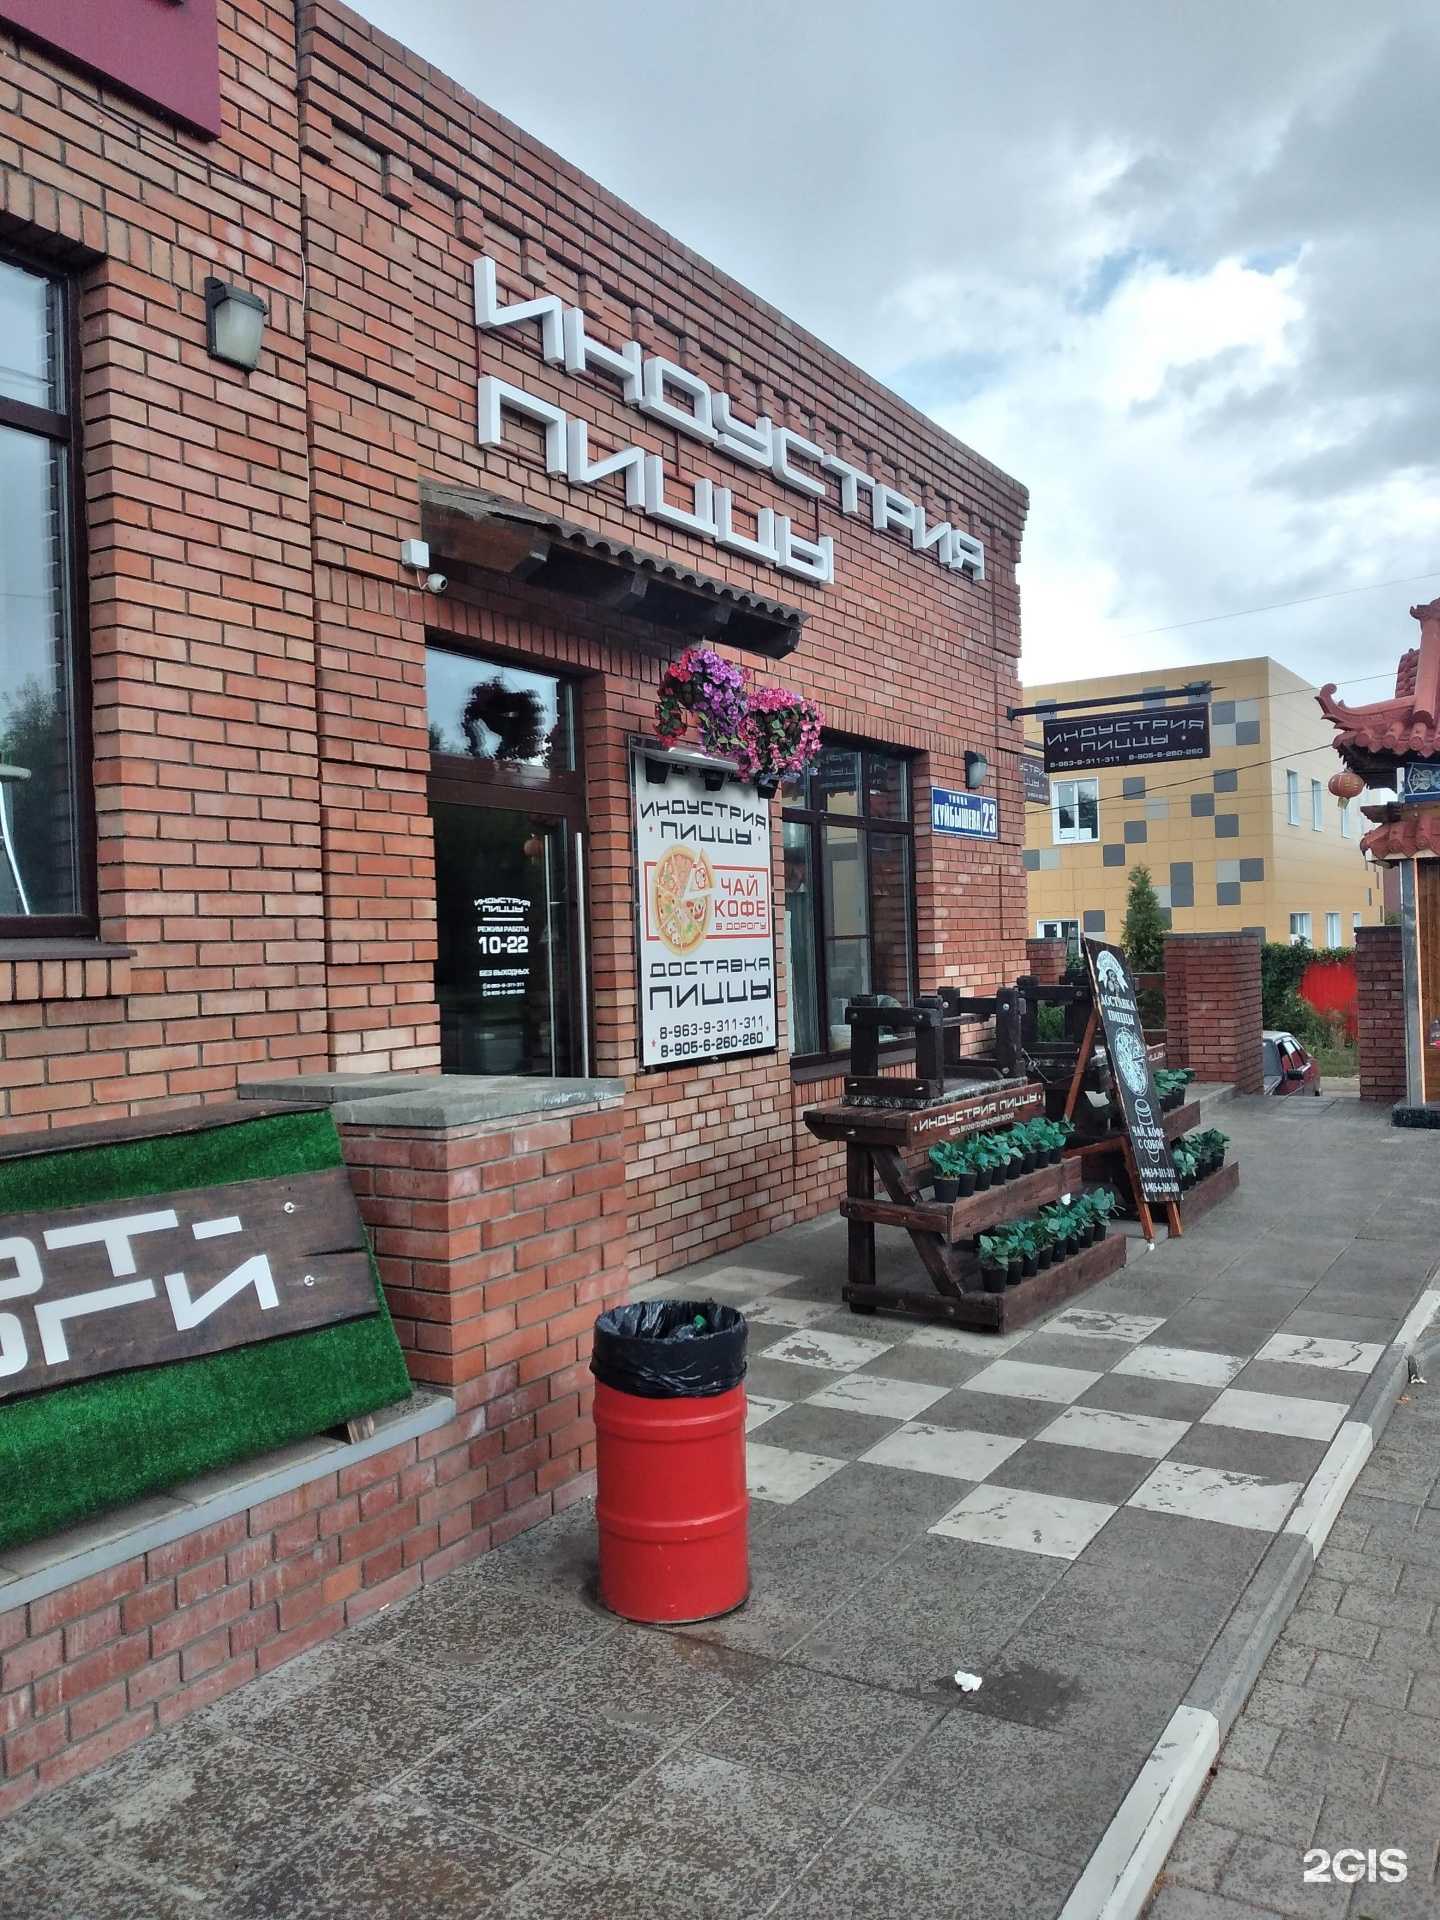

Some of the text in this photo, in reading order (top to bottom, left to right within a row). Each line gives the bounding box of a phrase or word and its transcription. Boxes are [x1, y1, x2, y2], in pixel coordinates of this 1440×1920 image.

[473, 256, 984, 581] ИНДУСТРИЯ
[478, 375, 834, 584] ПИЦЦЫ
[1047, 719, 1204, 746] ИНДУСТРИЯ
[1081, 734, 1168, 752] ПИЦЦЫ
[640, 800, 766, 830] ИНДУСТРИЯ
[934, 802, 996, 833] КУЙБЫШЕВА 23
[660, 821, 752, 846] ПИЦЦЫ
[720, 874, 759, 897] ЧАЙ
[474, 897, 531, 907] ИНДУСТРИЯ
[482, 905, 524, 913] ПИЦЦЫ
[714, 899, 766, 918] КОФЕ
[715, 921, 767, 931] В ДОРОГУ
[479, 935, 529, 954] 10-22
[649, 957, 770, 978] ДОСТАВКА
[649, 978, 771, 1011] ПИЦЦЫ
[659, 1015, 764, 1040] 8-963-9-311-311
[660, 1031, 764, 1058] 8-905-6-260-260
[919, 1102, 998, 1132] ИНДУСТРИЯ
[999, 1092, 1038, 1111] ПИЦЦЫ
